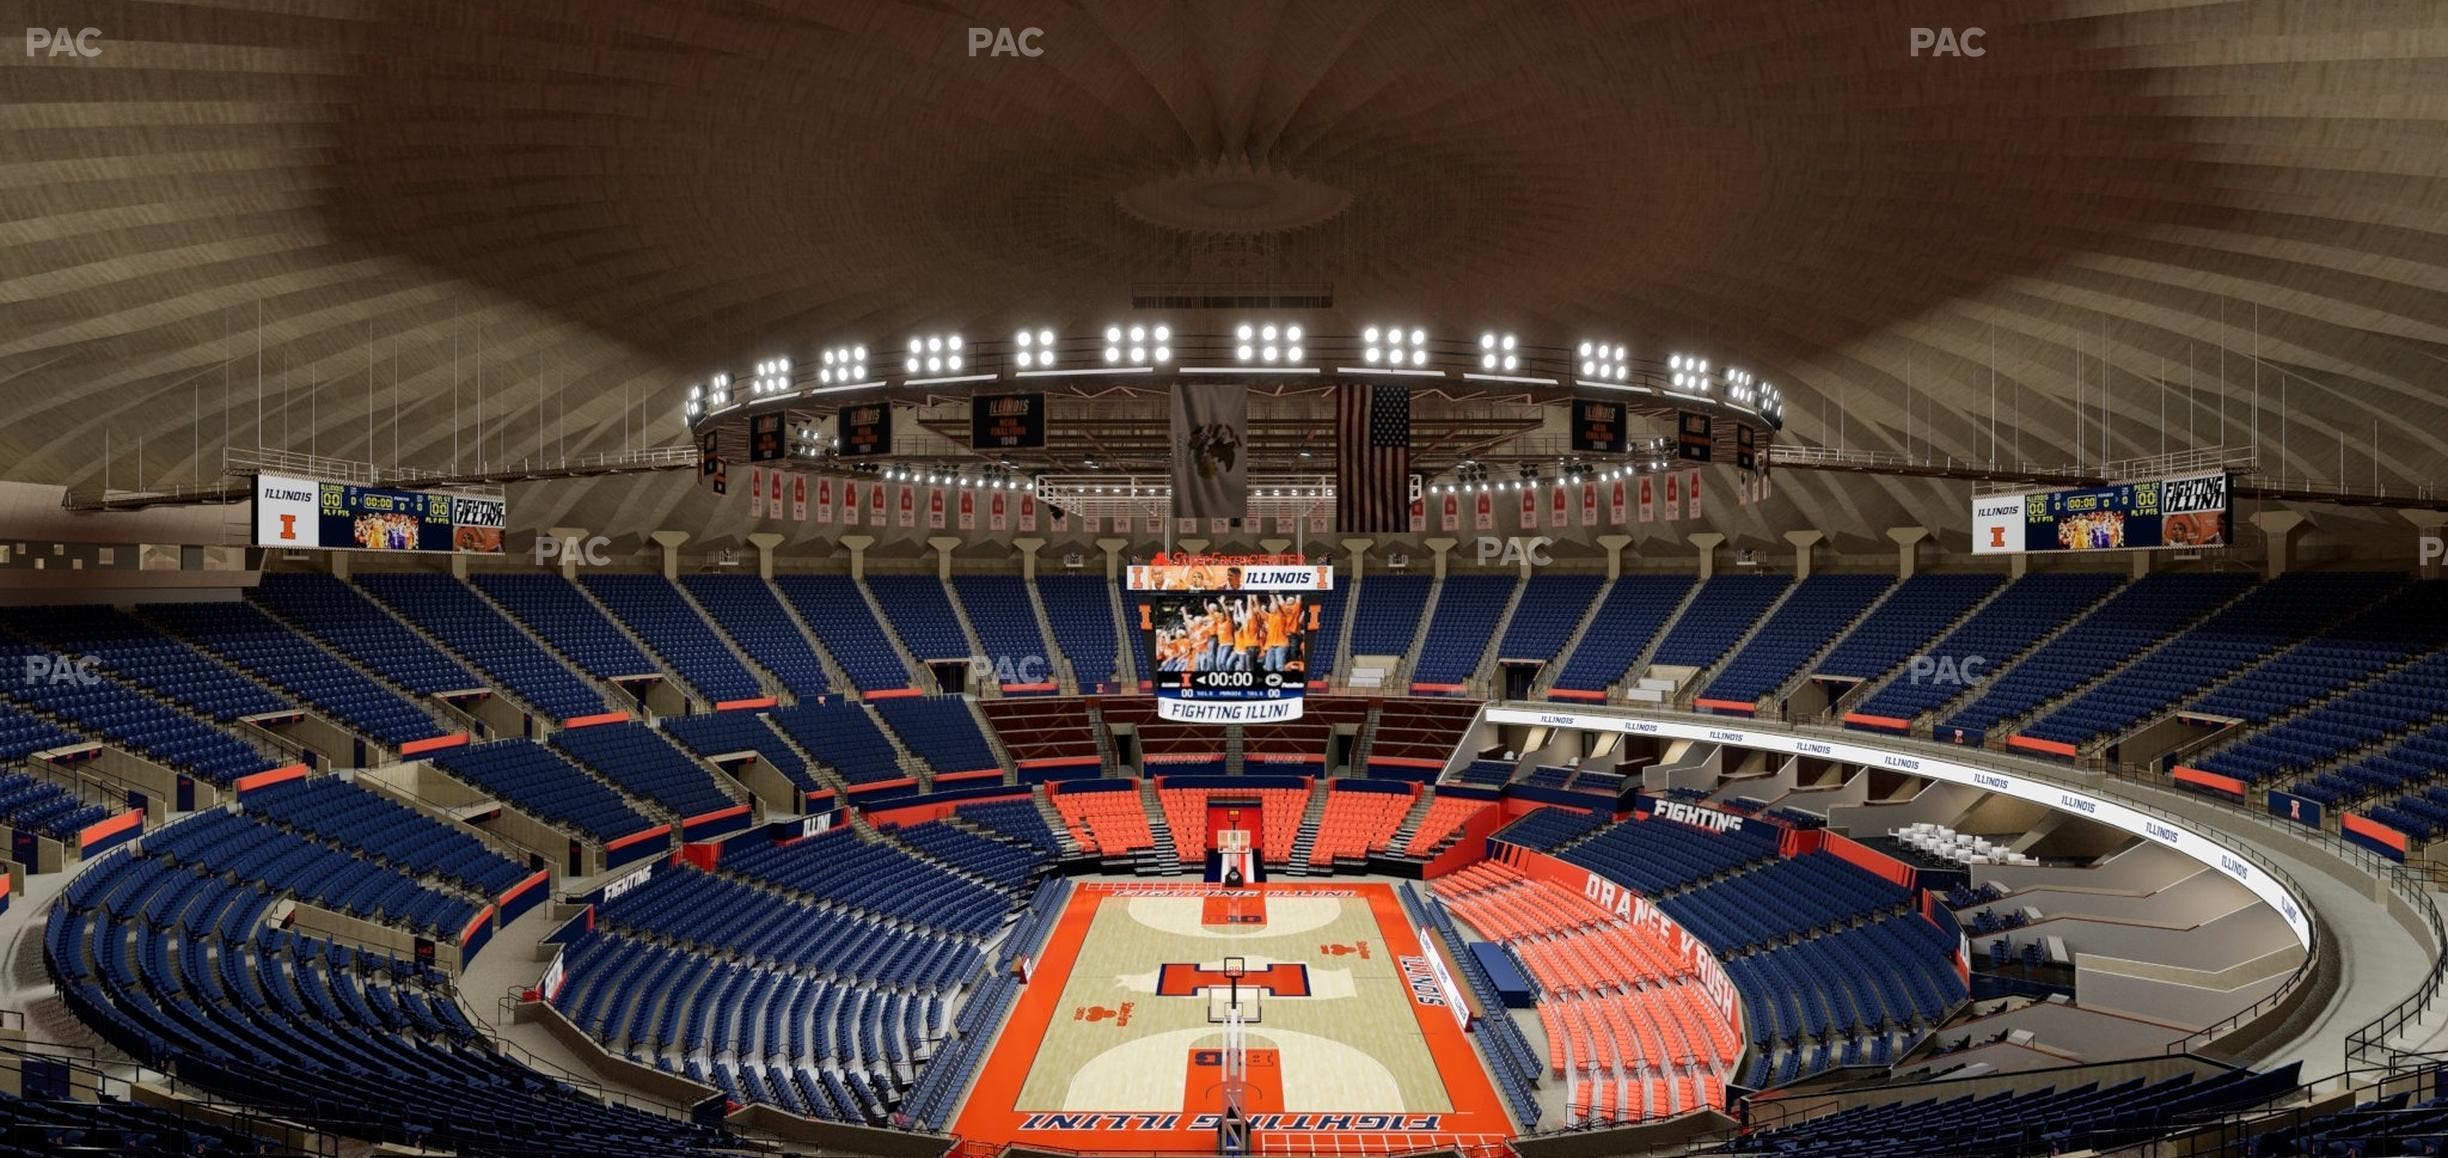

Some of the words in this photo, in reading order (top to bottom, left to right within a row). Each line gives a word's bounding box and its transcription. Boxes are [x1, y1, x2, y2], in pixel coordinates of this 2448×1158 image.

[2165, 476, 2224, 496] FIGHTING
[265, 488, 312, 502] ILLINOIS
[323, 493, 340, 506] 00
[2138, 492, 2156, 506] 00
[366, 497, 392, 508] 00:00
[431, 503, 447, 515] 00
[456, 499, 504, 515] FIGHTING
[2029, 503, 2045, 514] 00
[2069, 498, 2095, 509] 00:00
[1977, 505, 2019, 518] ILLINOIS
[1246, 572, 1311, 585] ILLINOIS
[1208, 672, 1253, 687] 00:00
[1181, 688, 1194, 698] 00
[1267, 688, 1280, 698] 00
[1172, 703, 1242, 719] FIGHTING
[1246, 703, 1289, 718] ILLINI
[1540, 715, 1575, 725] ILLINOIS
[1625, 722, 1658, 732] ILLINOIS
[1709, 730, 1743, 742] ILLINOIS
[1795, 742, 1831, 754] ILLINOIS
[1884, 756, 1920, 770] ILLINOIS
[1973, 773, 2009, 789] ILLINOIS
[2061, 794, 2096, 814] ILLINOIS
[1654, 799, 1744, 833] FIGHTING
[2146, 822, 2179, 843] ILLINOIS
[2221, 854, 2248, 880] ILLINOIS
[603, 864, 653, 904] FIGHTING
[1399, 955, 1448, 1007] ILLINOIS
[1017, 1113, 1183, 1131] ILLINI
